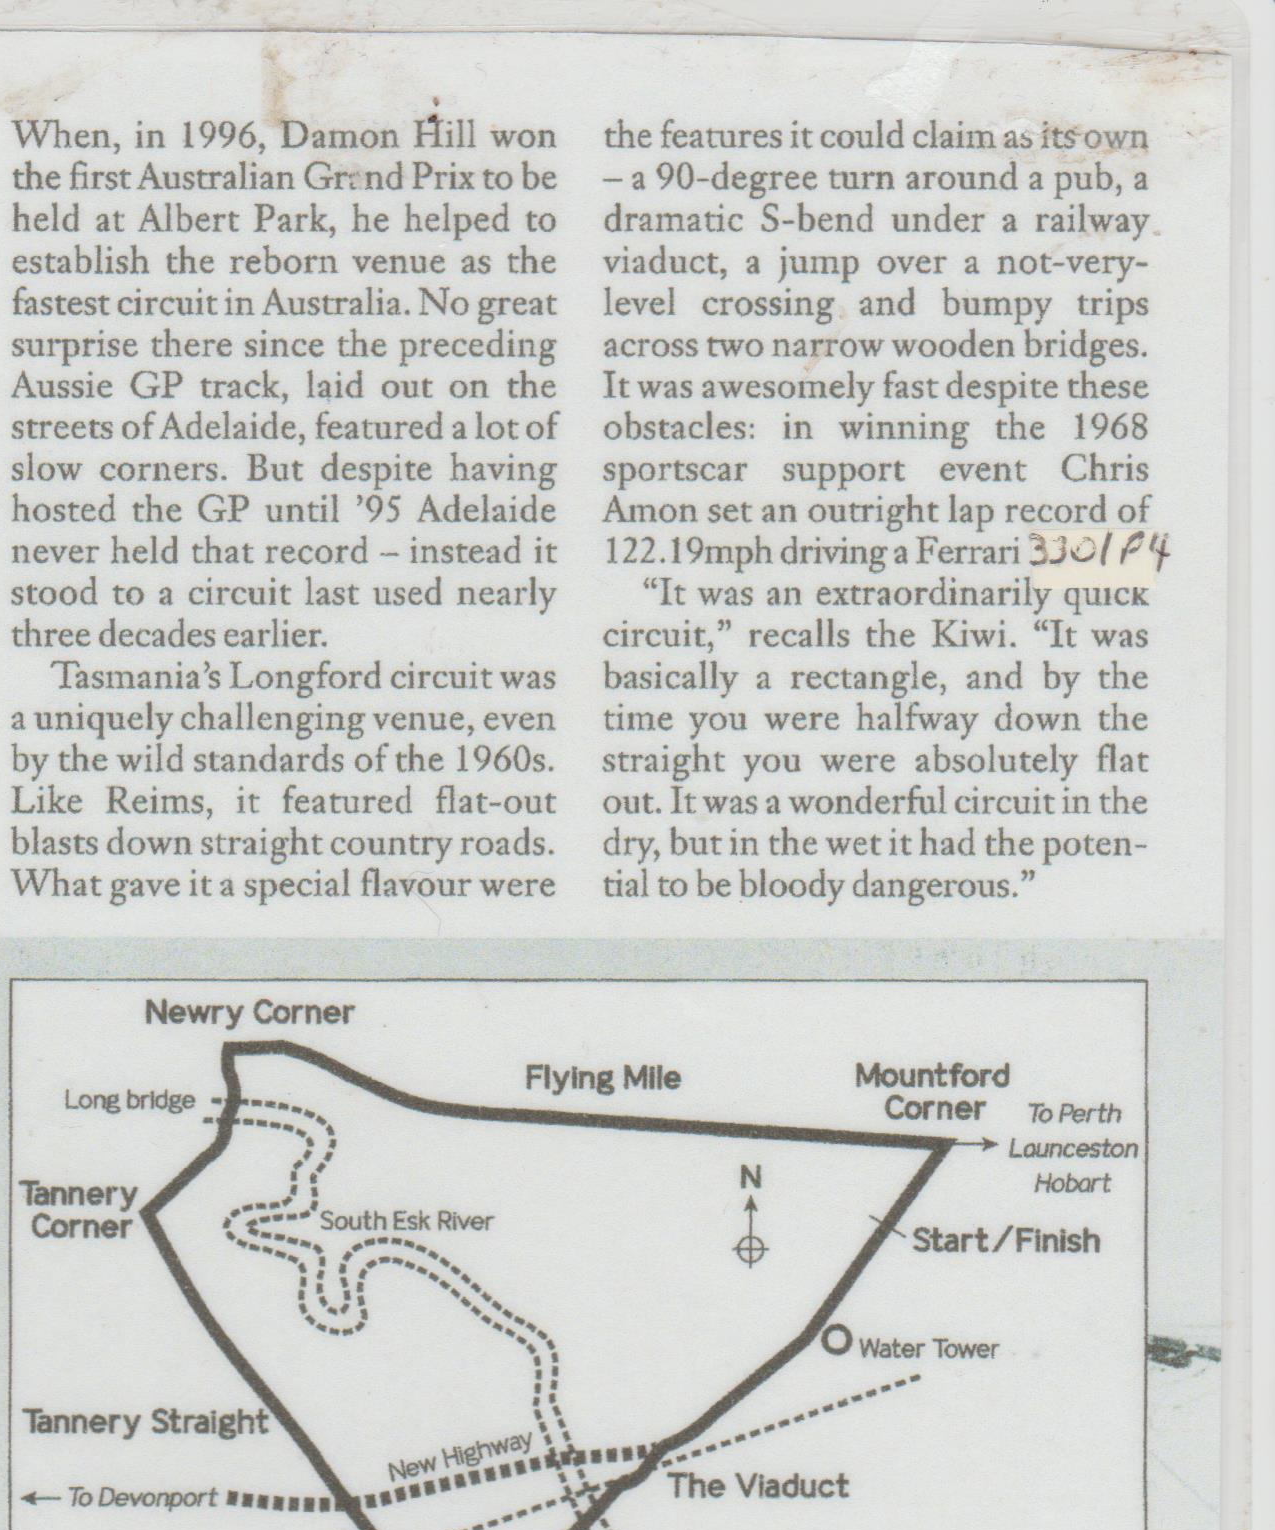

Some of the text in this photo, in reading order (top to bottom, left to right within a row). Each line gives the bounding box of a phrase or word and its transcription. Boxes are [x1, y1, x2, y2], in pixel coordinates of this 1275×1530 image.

[12, 119, 556, 154] When, in 1996, Damon Hill won
[605, 202, 1149, 241] dramatic S-bend under a railway
[604, 287, 1148, 325] level crossing and bumpy trips
[12, 328, 556, 367] surprise there since the preceding
[604, 411, 1147, 449] obstacles: in winning the 1968
[12, 452, 557, 490] slow corners. But despite having
[603, 453, 1148, 491] sportscar support event Chris
[605, 536, 1020, 574] 122.19mph driving a Ferrari
[698, 587, 753, 606] was
[768, 587, 801, 605] an
[817, 577, 1052, 615] extraordinarily
[1064, 587, 1149, 615] quick
[12, 618, 327, 648] three decades earlier.
[12, 701, 555, 740] a uniquely challenging venue, even
[603, 743, 1148, 782] straight you were absolutely flat
[12, 784, 556, 819] Like Reims, it featured flat-out
[146, 999, 355, 1030] Newry Corner
[527, 1064, 681, 1096] Flying Mile
[856, 1062, 1010, 1088] Mountford
[65, 1089, 195, 1114] Long bridge
[885, 1095, 986, 1120] Corner
[1029, 1103, 1121, 1123] To Perth
[1009, 1138, 1138, 1158] Launceston
[741, 1165, 761, 1188] N
[1035, 1173, 1111, 1193] Hobart
[19, 1180, 137, 1212] Tannery
[32, 1213, 132, 1239] Corner
[321, 1210, 494, 1231] South Esk River
[859, 1338, 999, 1358] Water Tower
[22, 1408, 269, 1440] Tannery Straight
[388, 1431, 533, 1482] New Highway
[69, 1487, 218, 1512] To Devonport
[667, 1472, 849, 1498] The Viaduct
